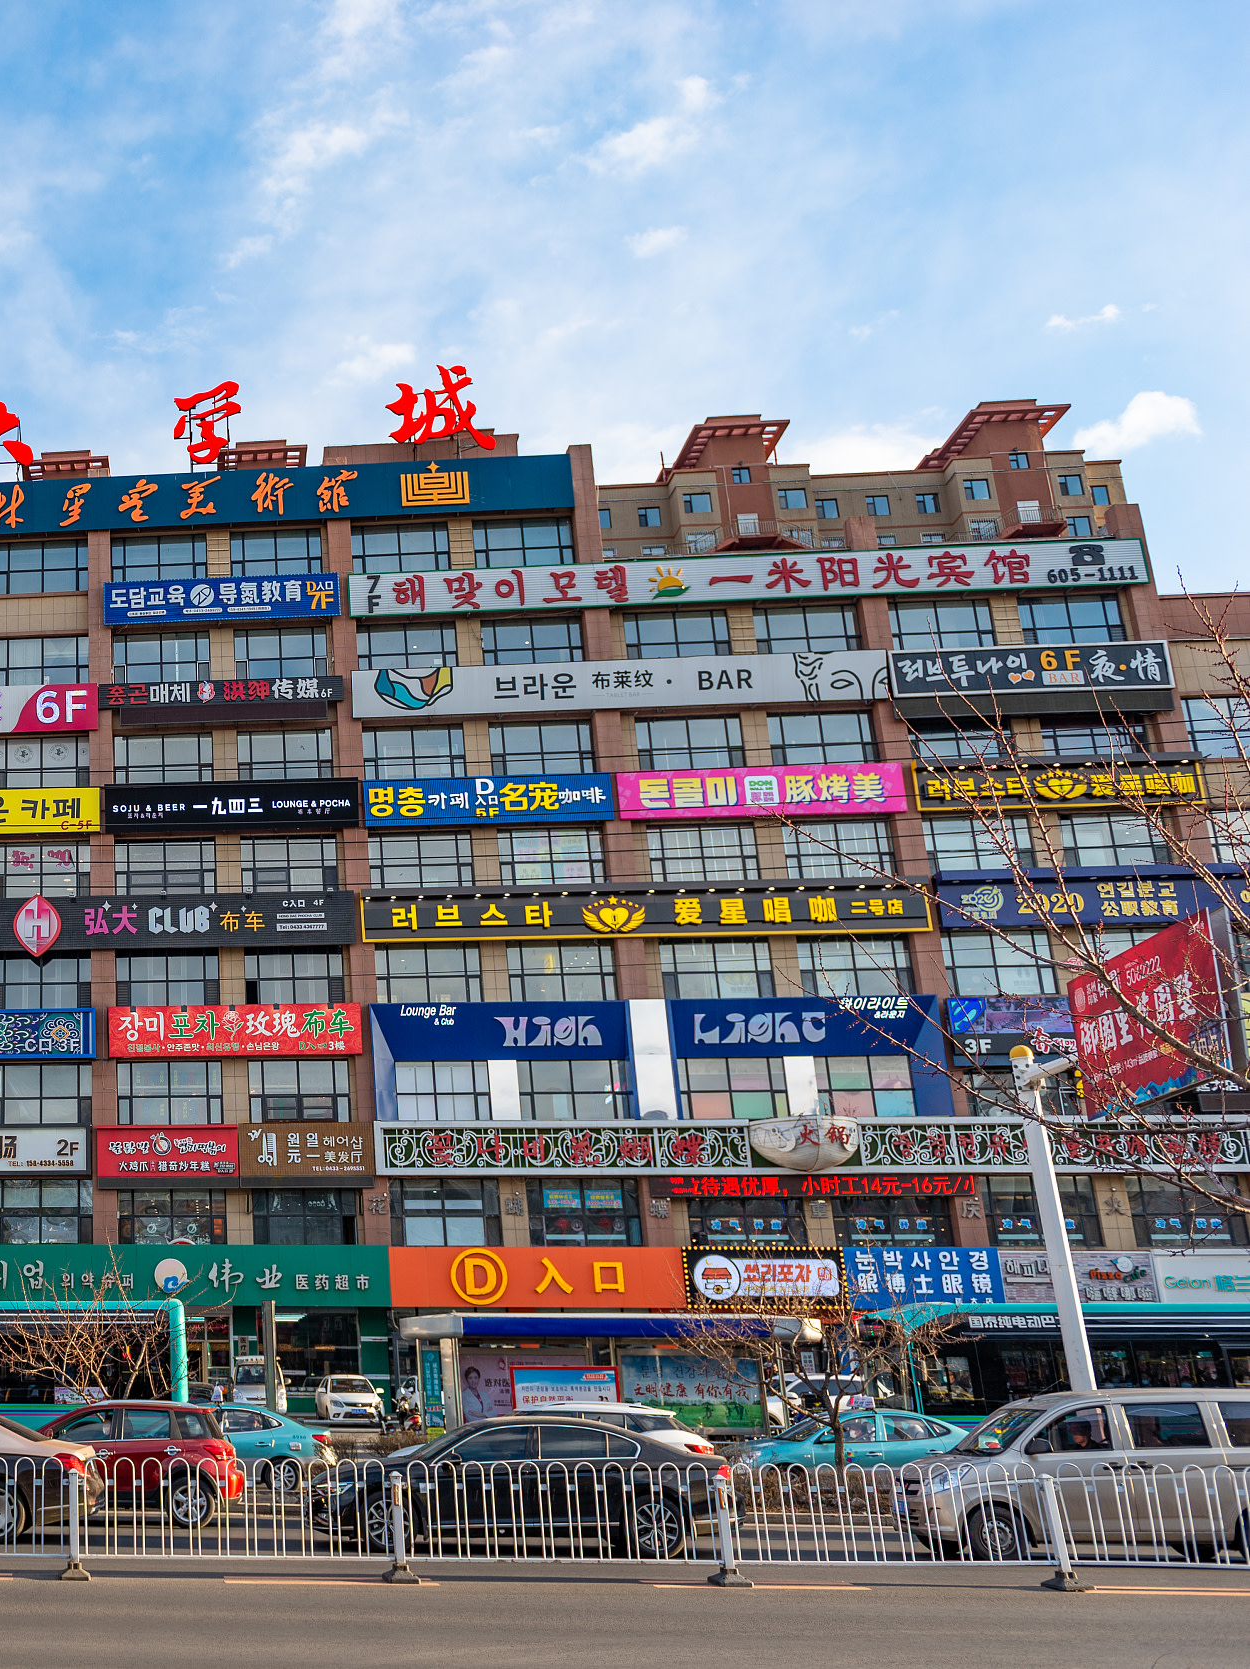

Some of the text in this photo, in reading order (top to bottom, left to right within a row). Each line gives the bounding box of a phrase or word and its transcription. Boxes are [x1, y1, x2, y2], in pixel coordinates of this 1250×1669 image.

[708, 549, 1030, 593] 一米阳光宾馆
[1047, 565, 1138, 584] 605-1111
[110, 585, 185, 608] 도담교육
[310, 591, 334, 610] 7F
[494, 672, 576, 701] 브라운
[591, 669, 653, 690] 布莱纹
[698, 669, 753, 692] BAR
[1048, 672, 1081, 683] BAR
[321, 688, 333, 698] 6F
[35, 689, 88, 724] 6F
[475, 778, 494, 795] D
[784, 773, 886, 805] 豚烤美
[20, 797, 81, 820] 카페
[112, 804, 140, 812] SOJU
[157, 803, 186, 811] BEER
[193, 797, 263, 815] 一九四三
[272, 800, 308, 808] LOUNGE
[319, 799, 350, 807] POCHA
[475, 796, 498, 806] 入口
[1096, 881, 1176, 898] 연길분교
[282, 900, 305, 908] C入口
[673, 896, 905, 926] 爱星唱咖 二号店
[1101, 900, 1178, 917] 公职教育
[84, 906, 137, 935] 弘大
[148, 905, 210, 935] CLUB
[219, 910, 265, 933] 布车
[391, 901, 553, 931] 러브스타
[400, 1005, 456, 1018] Lounge Bar
[246, 1008, 355, 1039] 玫瑰布车
[59, 1038, 79, 1052] 3F
[965, 1039, 991, 1054] 3F
[287, 1132, 363, 1150] 원일 헤어샵
[800, 1122, 850, 1146] 火锅
[57, 1140, 79, 1156] 2F
[119, 1160, 148, 1172] 火鸡爪
[158, 1160, 211, 1172] 猎奇炒年糕
[961, 1199, 983, 1219] 庆
[1104, 1198, 1124, 1215] 火
[855, 1252, 989, 1271] 눈박사안경
[208, 1258, 370, 1292] 伟业 医药超市
[535, 1257, 625, 1294] 入口
[1089, 1268, 1123, 1280] Pizza
[857, 1273, 993, 1295] 眼博士眼镜
